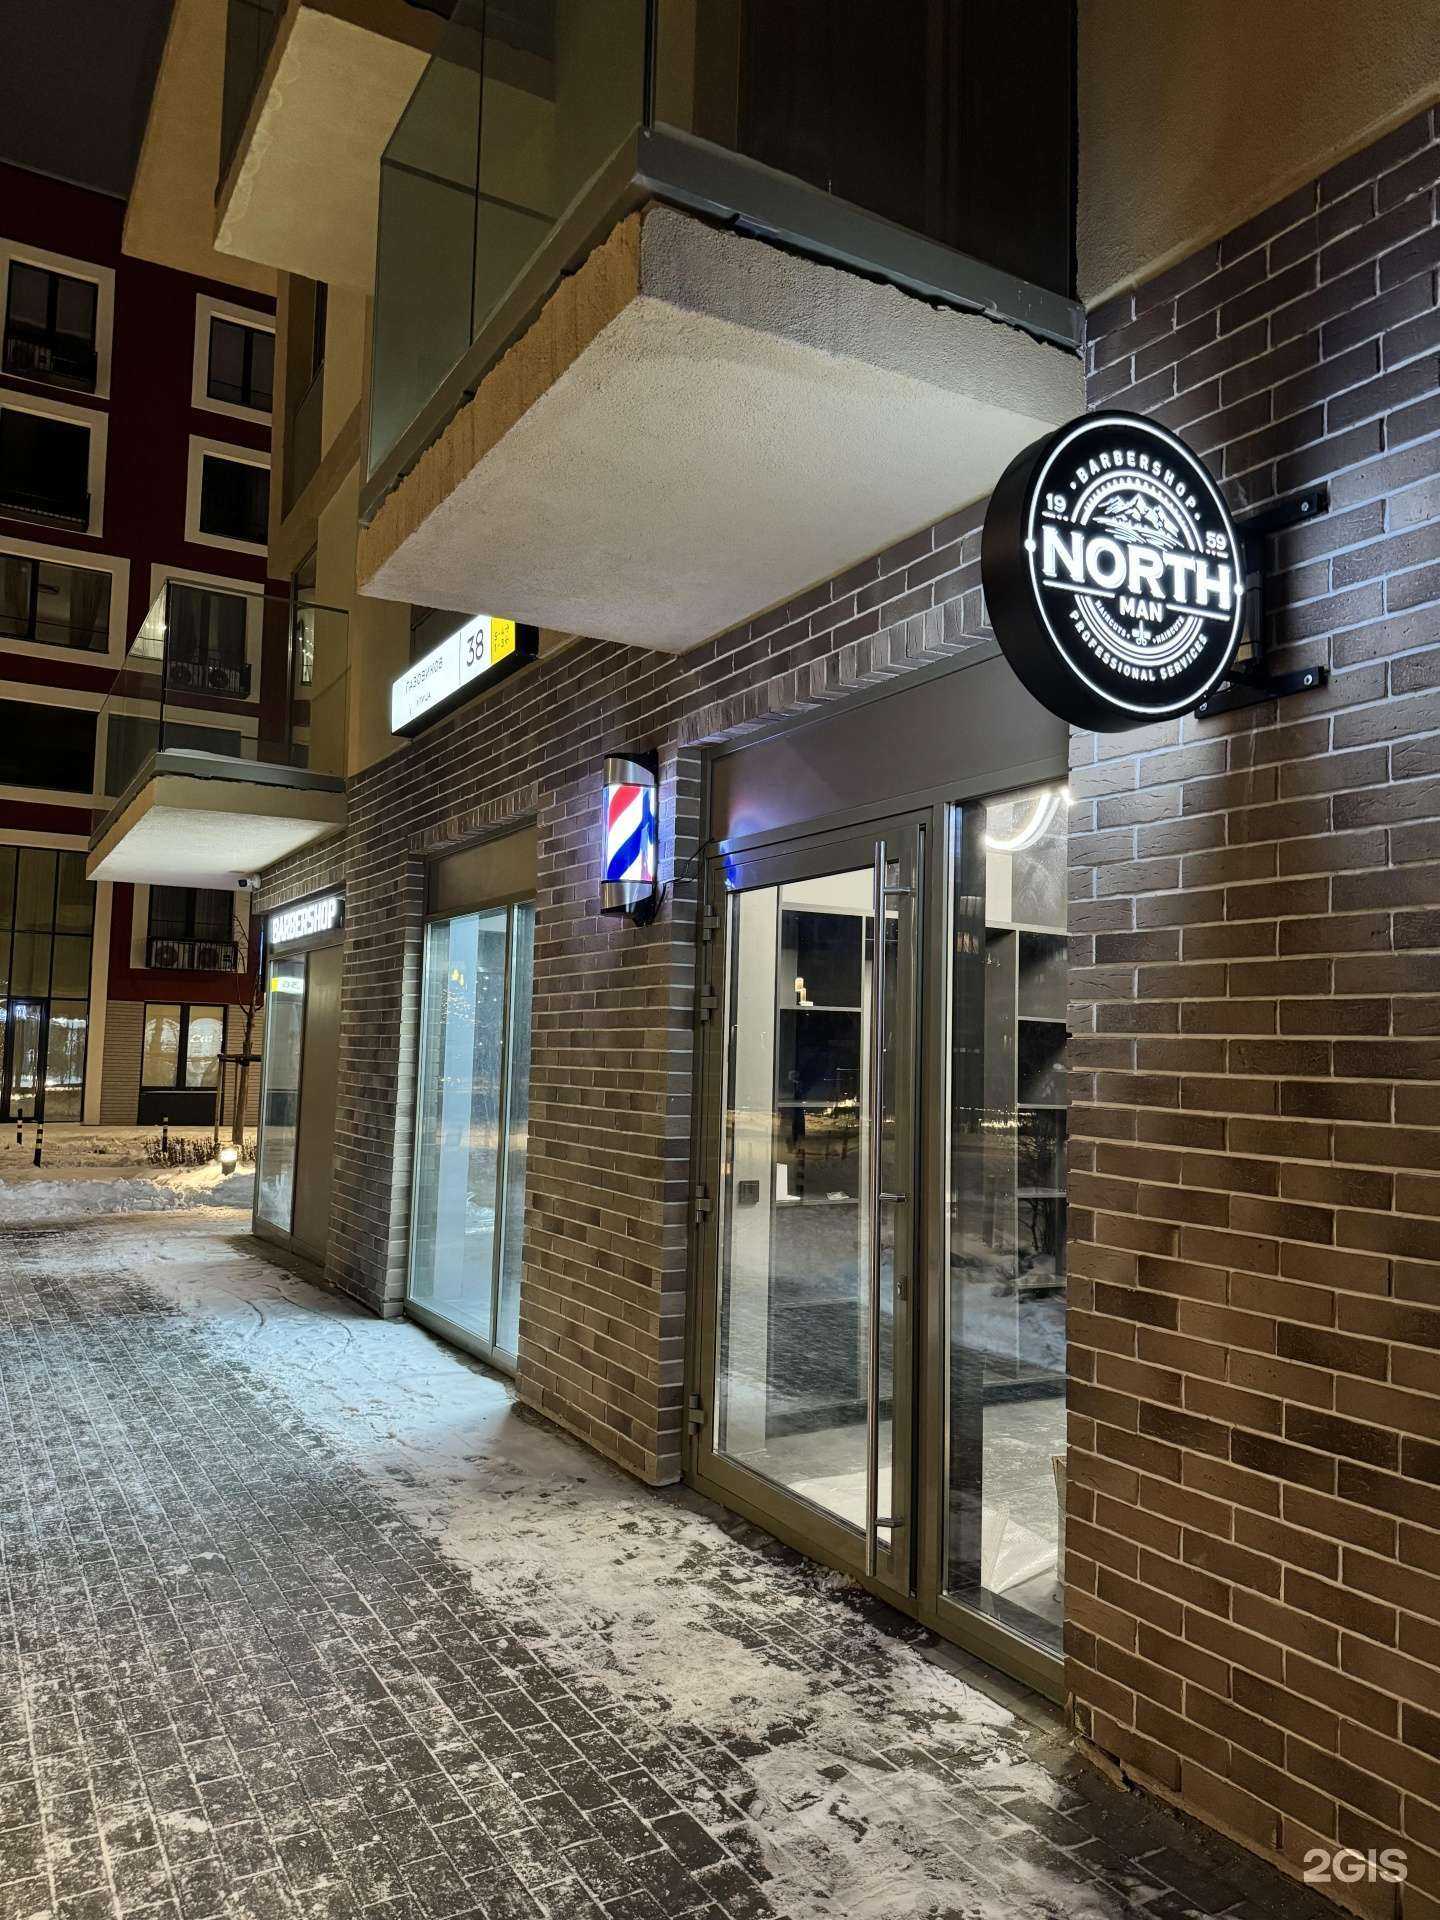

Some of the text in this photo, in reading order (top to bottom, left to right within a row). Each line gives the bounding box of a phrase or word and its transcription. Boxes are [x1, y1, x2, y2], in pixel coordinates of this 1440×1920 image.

[1045, 493, 1067, 513] 19
[1075, 450, 1198, 514] BARBERSHOP
[1205, 532, 1227, 551] 59
[1040, 525, 1231, 610] NORTH
[1119, 596, 1164, 623] MAN
[466, 628, 484, 667] 38
[1069, 610, 1208, 682] PROFESSIONAL SERVICES
[272, 898, 337, 944] BARBERSHOP
